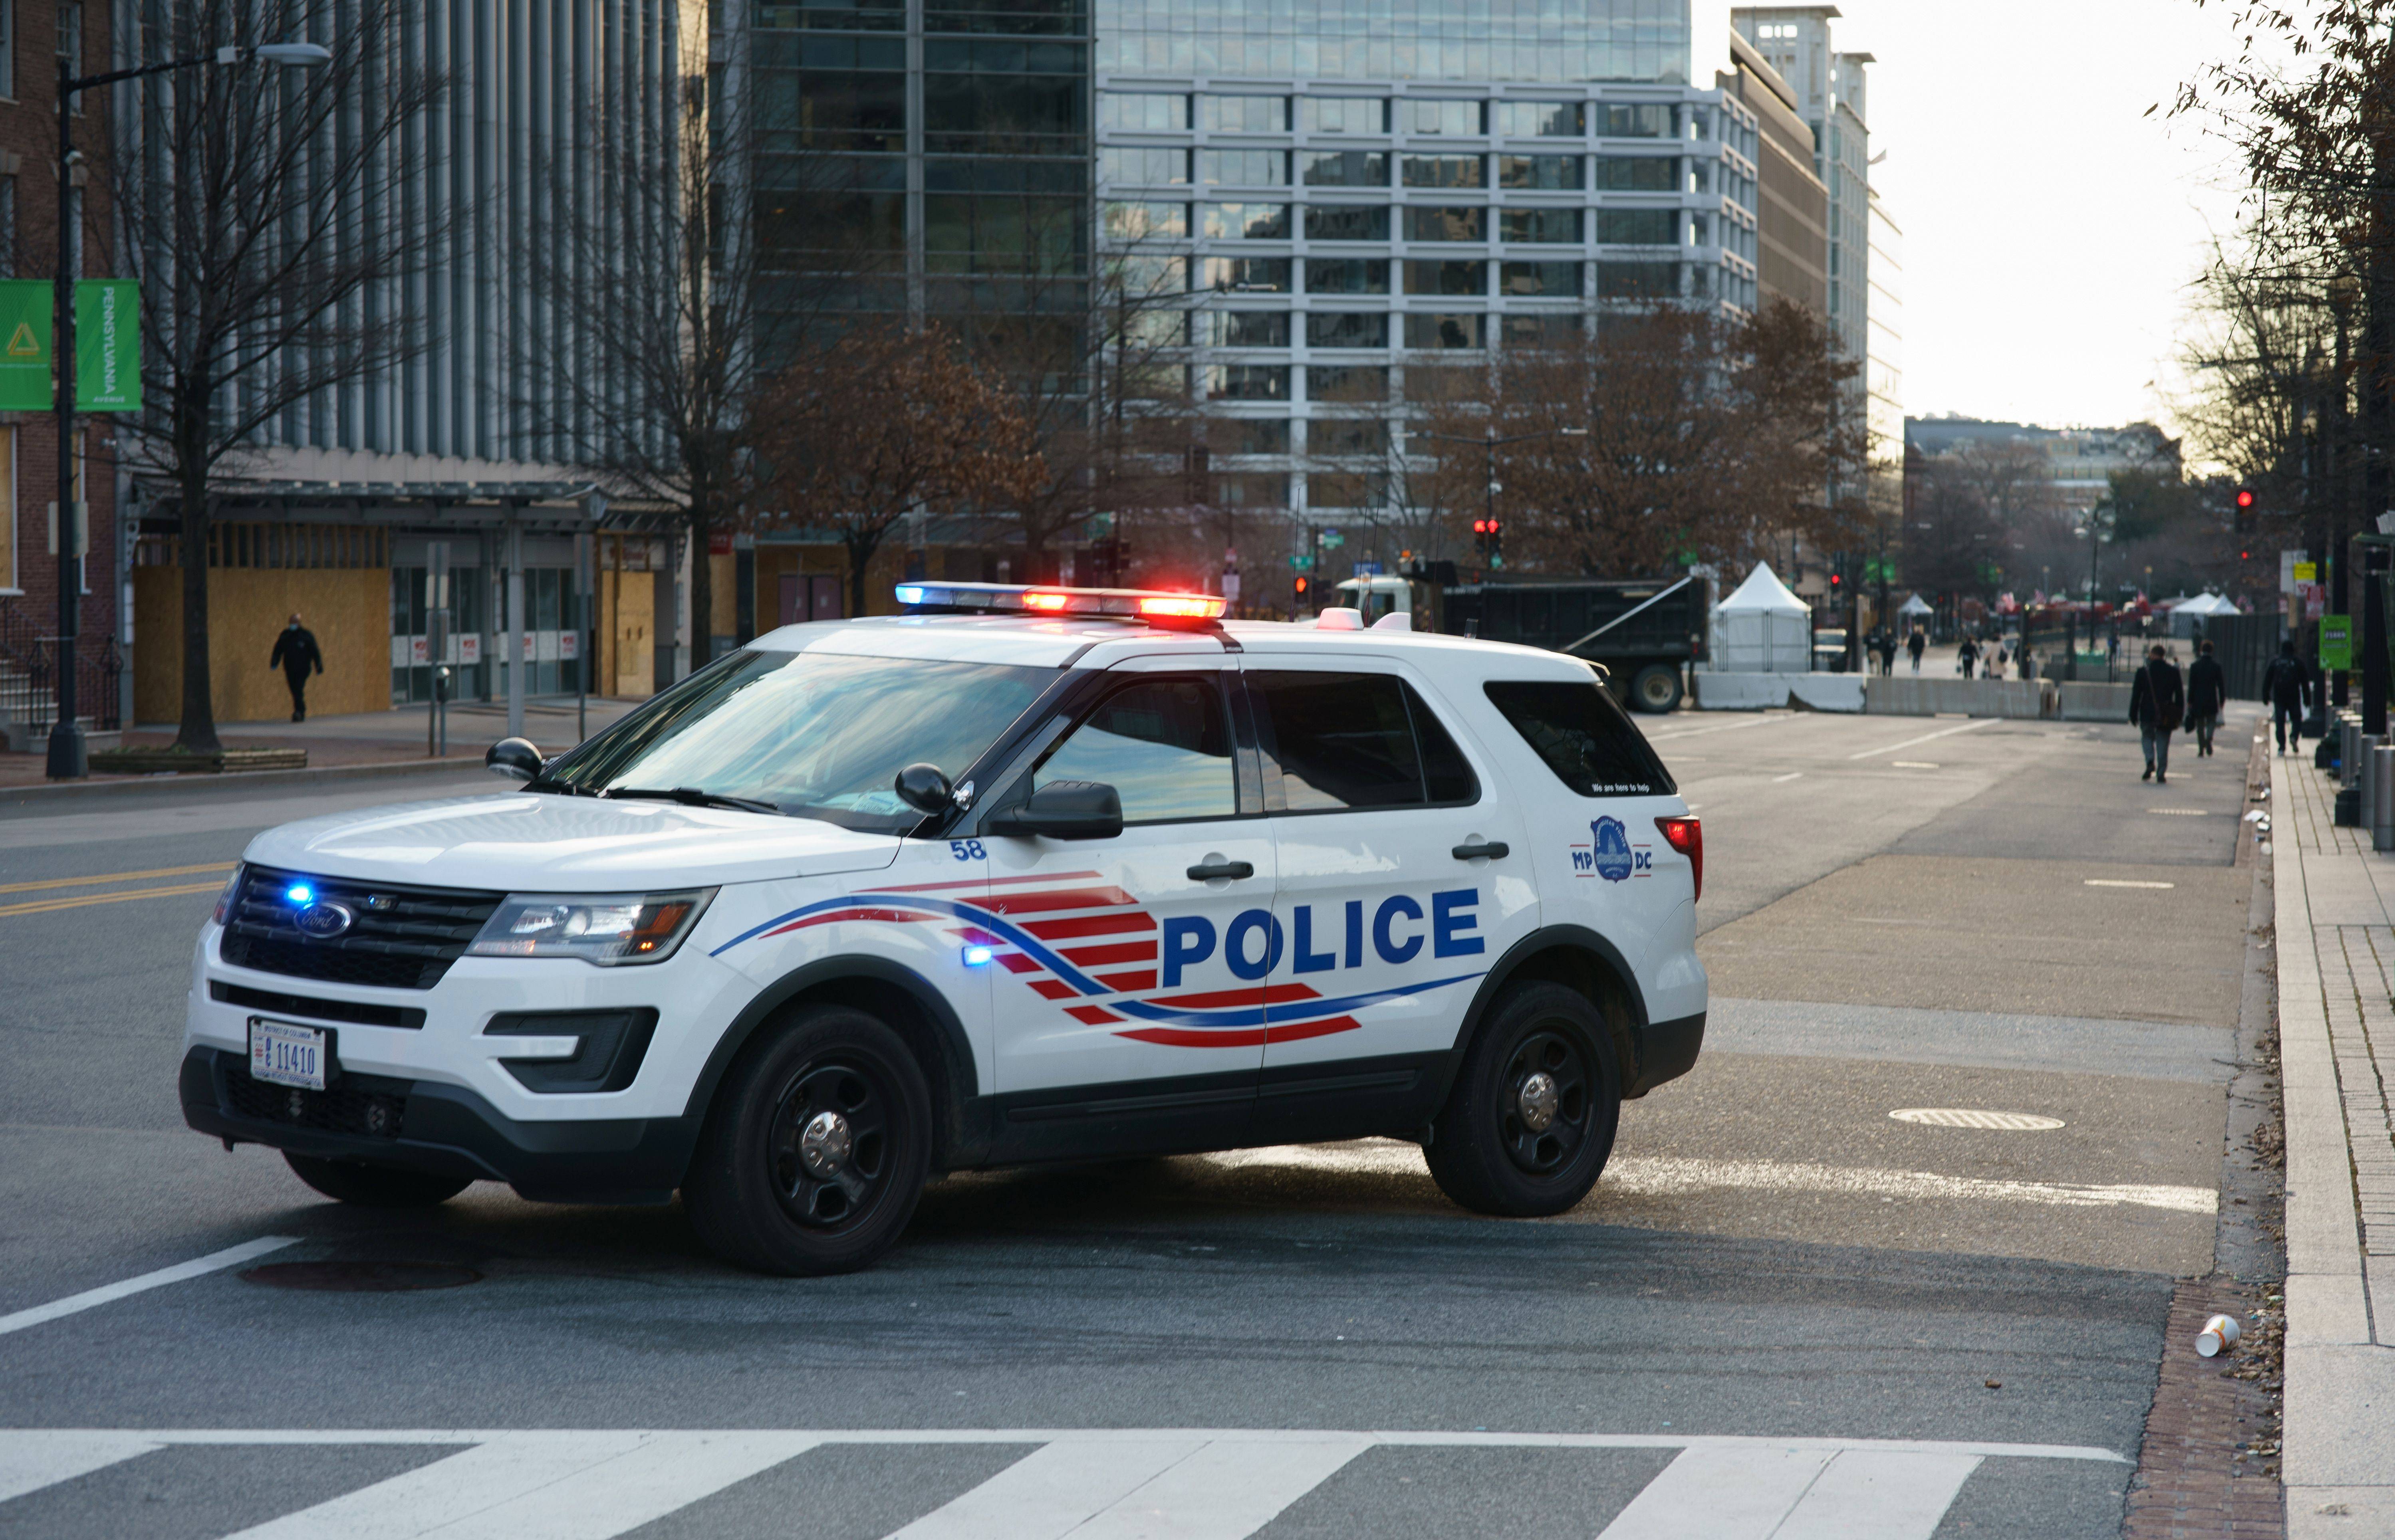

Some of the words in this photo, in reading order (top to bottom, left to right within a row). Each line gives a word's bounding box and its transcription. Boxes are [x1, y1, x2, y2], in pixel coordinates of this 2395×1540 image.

[103, 286, 116, 394] PENNSYLVANIA
[1591, 783, 1603, 792] We
[1615, 783, 1629, 792] here
[1629, 783, 1636, 792] to
[1637, 783, 1650, 793] help
[950, 839, 987, 860] 58
[1572, 851, 1593, 870] MP
[1635, 852, 1652, 870] DC
[302, 908, 335, 929] Ford
[1163, 888, 1485, 988] POLICE
[277, 1041, 315, 1075] 11410
